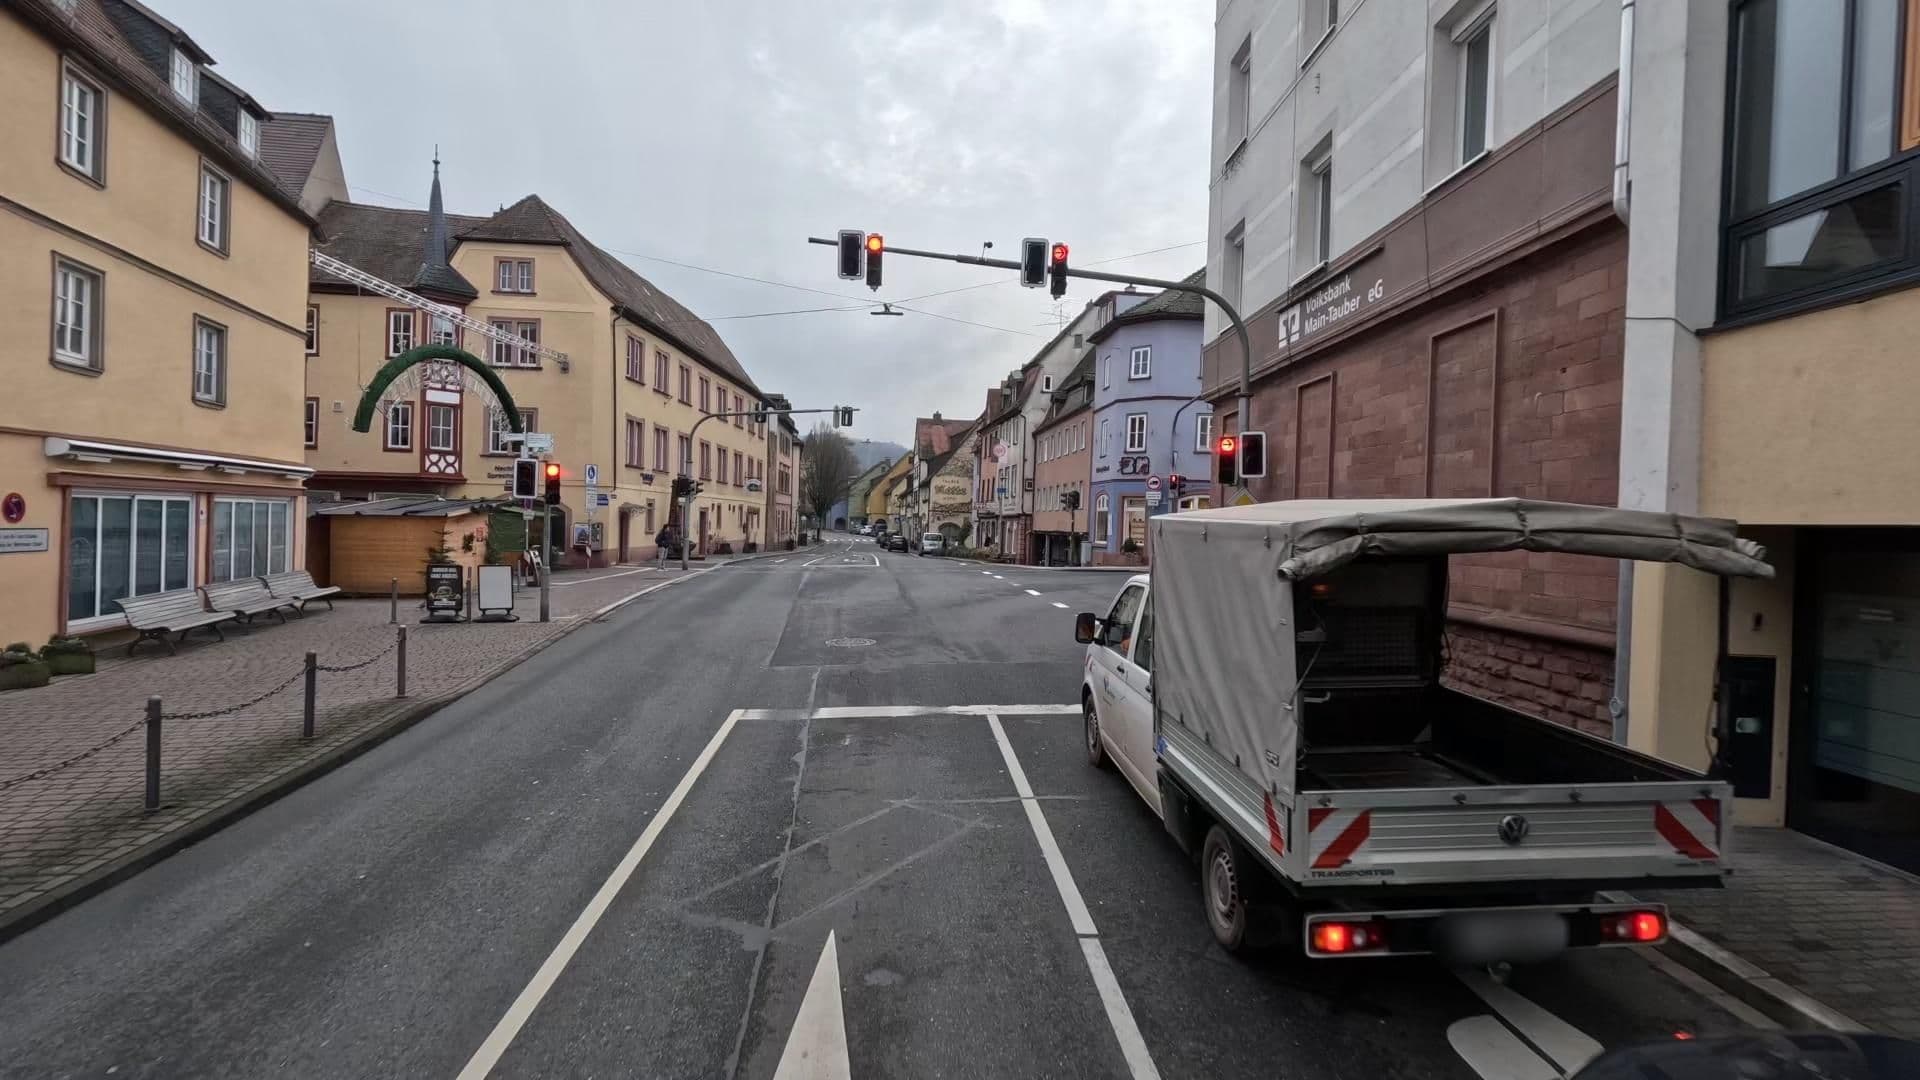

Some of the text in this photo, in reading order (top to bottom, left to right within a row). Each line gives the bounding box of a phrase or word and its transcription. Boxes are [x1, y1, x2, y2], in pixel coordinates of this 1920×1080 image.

[1305, 279, 1383, 335] Main-Tauber eG
[1306, 275, 1351, 313] Volksbank
[1311, 868, 1395, 878] TRANSPORTER
